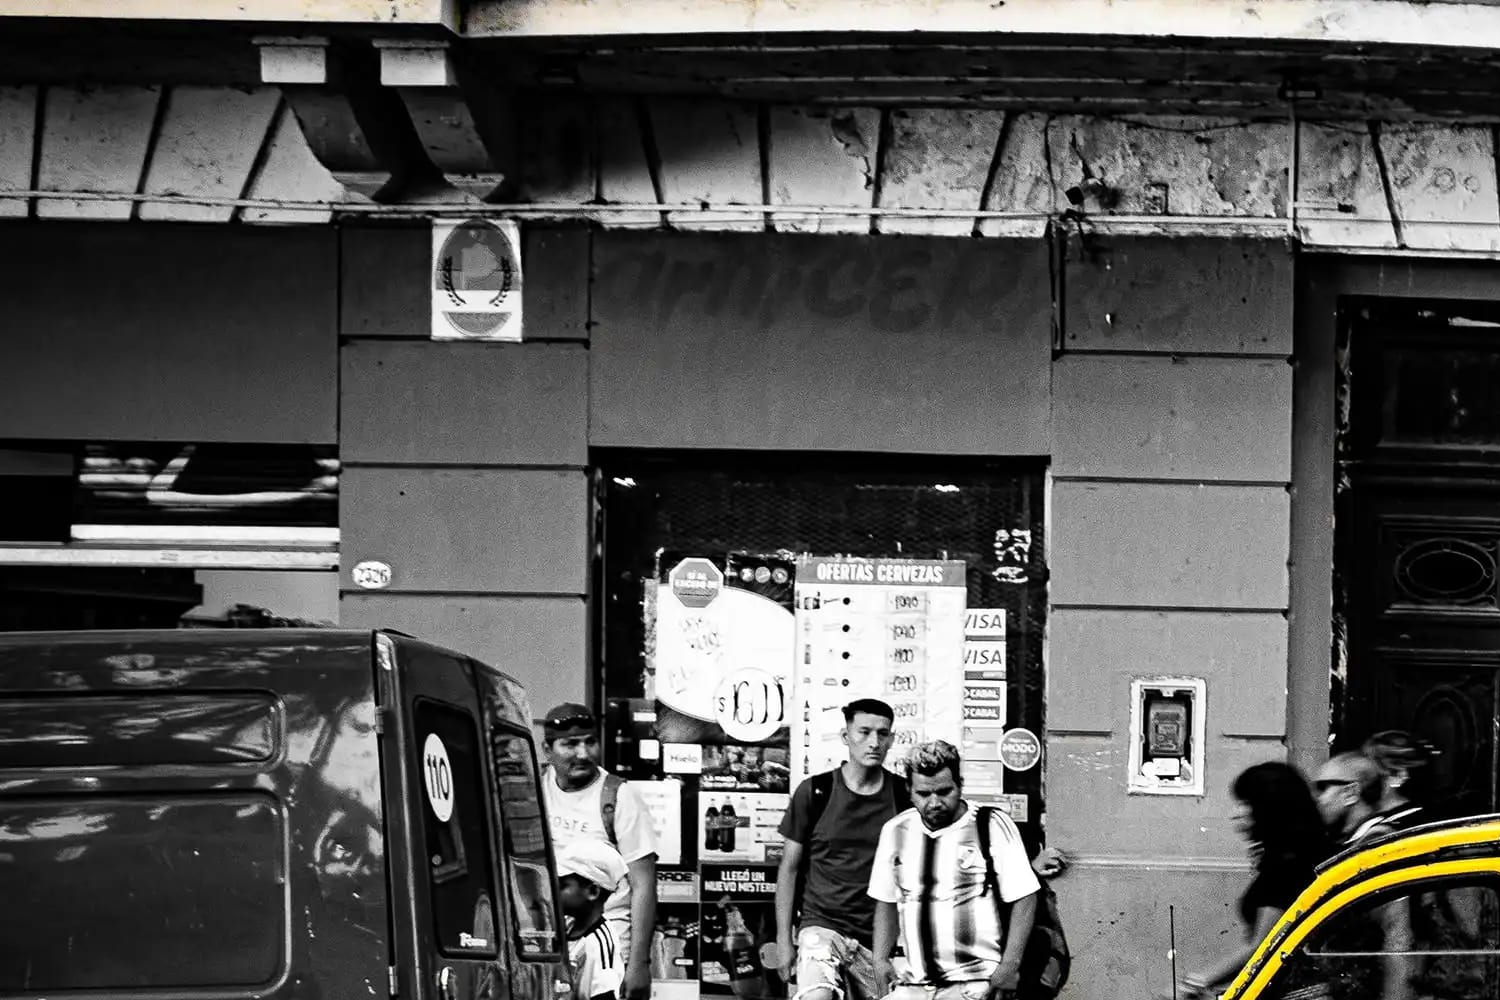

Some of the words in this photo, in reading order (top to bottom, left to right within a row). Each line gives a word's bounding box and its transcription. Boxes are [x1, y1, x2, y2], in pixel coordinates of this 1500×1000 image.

[817, 562, 874, 581] OFERTAS
[877, 564, 944, 583] CERVEZAS
[965, 614, 1002, 629] VISA
[965, 649, 1002, 665] VISA
[972, 688, 999, 699] CABAL
[971, 707, 999, 718] CABAL
[1002, 743, 1037, 753] MODO
[427, 754, 449, 800] 110
[553, 816, 589, 833] OSTE
[656, 871, 693, 881] RADE
[721, 869, 750, 881] LLEGÓ
[751, 871, 765, 882] UN
[705, 880, 737, 892] NUEVO
